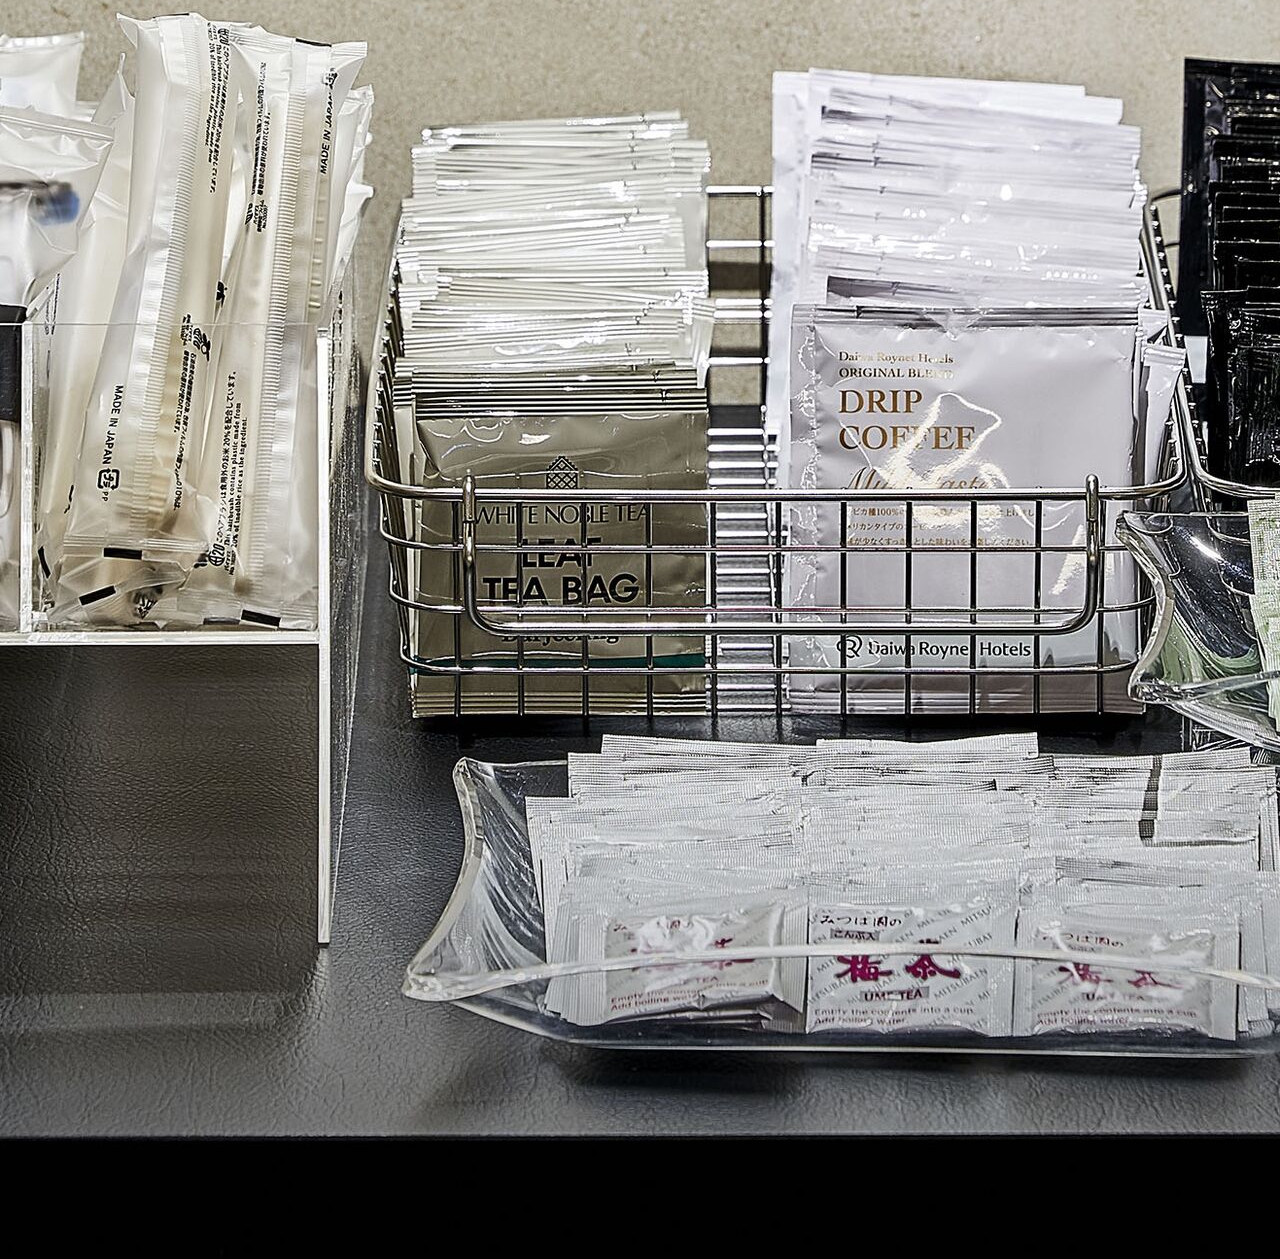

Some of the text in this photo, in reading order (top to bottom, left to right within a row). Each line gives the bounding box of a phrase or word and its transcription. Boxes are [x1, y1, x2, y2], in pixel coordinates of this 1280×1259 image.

[320, 130, 331, 174] MADE IN
[877, 352, 915, 364] Roynet
[839, 368, 904, 378] ORIGINAL
[838, 390, 922, 413] DRIP
[103, 386, 123, 464] MADE IN JAPAN
[231, 442, 239, 464] plastic
[102, 492, 108, 501] PP
[476, 505, 538, 524] WHITE
[615, 505, 648, 522] TEA
[483, 573, 639, 606] TEA BAG
[920, 642, 968, 660] Royne
[980, 642, 1031, 656] Hotels
[900, 989, 923, 1000] TEA
